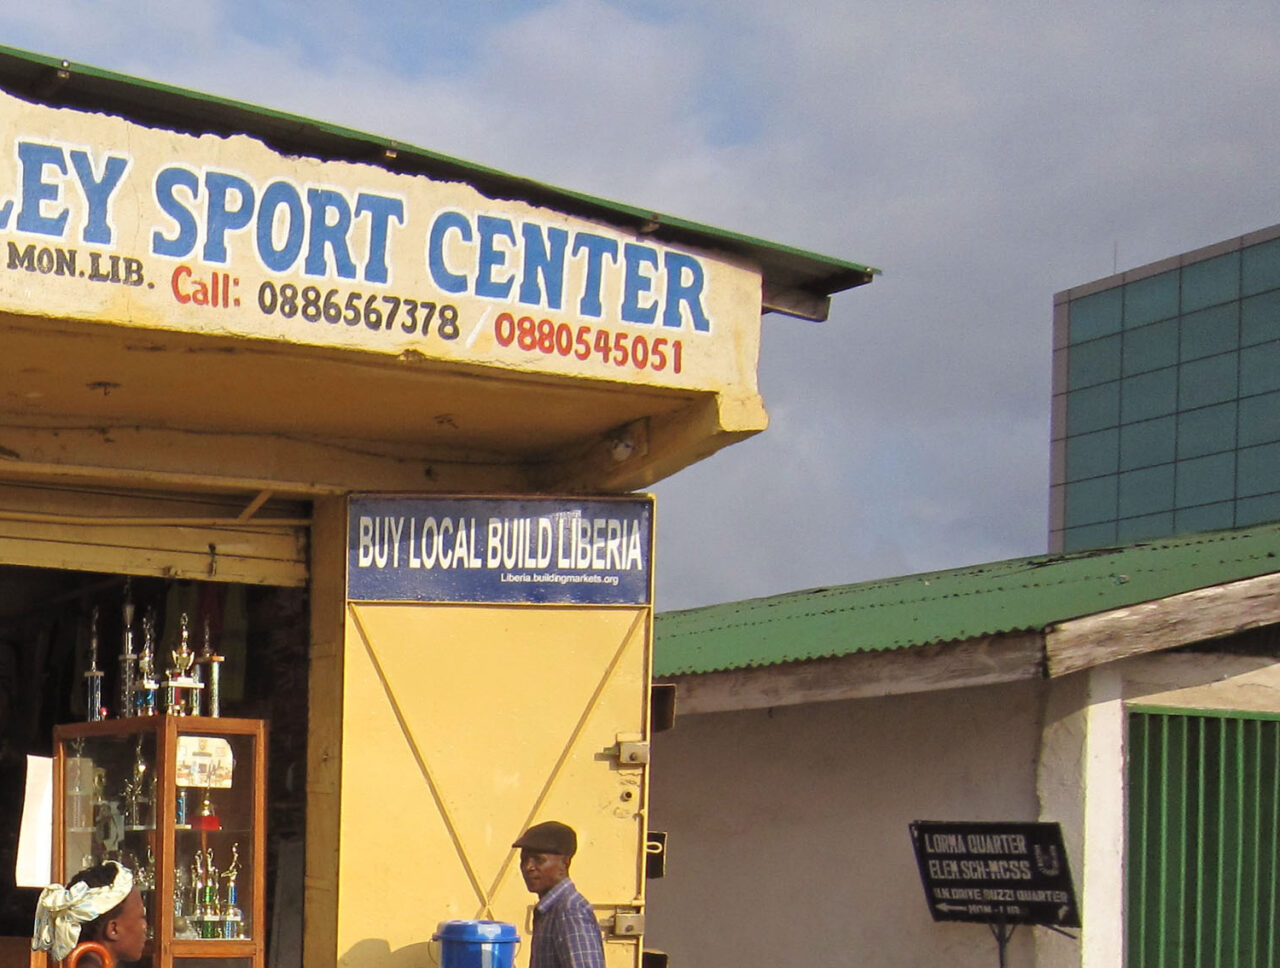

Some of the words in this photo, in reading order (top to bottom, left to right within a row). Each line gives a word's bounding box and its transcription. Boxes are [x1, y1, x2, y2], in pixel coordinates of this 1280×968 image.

[151, 167, 404, 285] SPORT
[428, 211, 710, 332] CENTER
[171, 265, 241, 308] Call:
[258, 281, 460, 340] 0886567378
[494, 312, 683, 374] 0880545051
[358, 516, 405, 569] BUY
[408, 516, 482, 570] LOCAL
[487, 517, 552, 570] BUILD
[557, 517, 642, 571] LIBERIA
[500, 573, 619, 586] Liberia.buildingmarkets.org
[967, 834, 1028, 855] QUARTER
